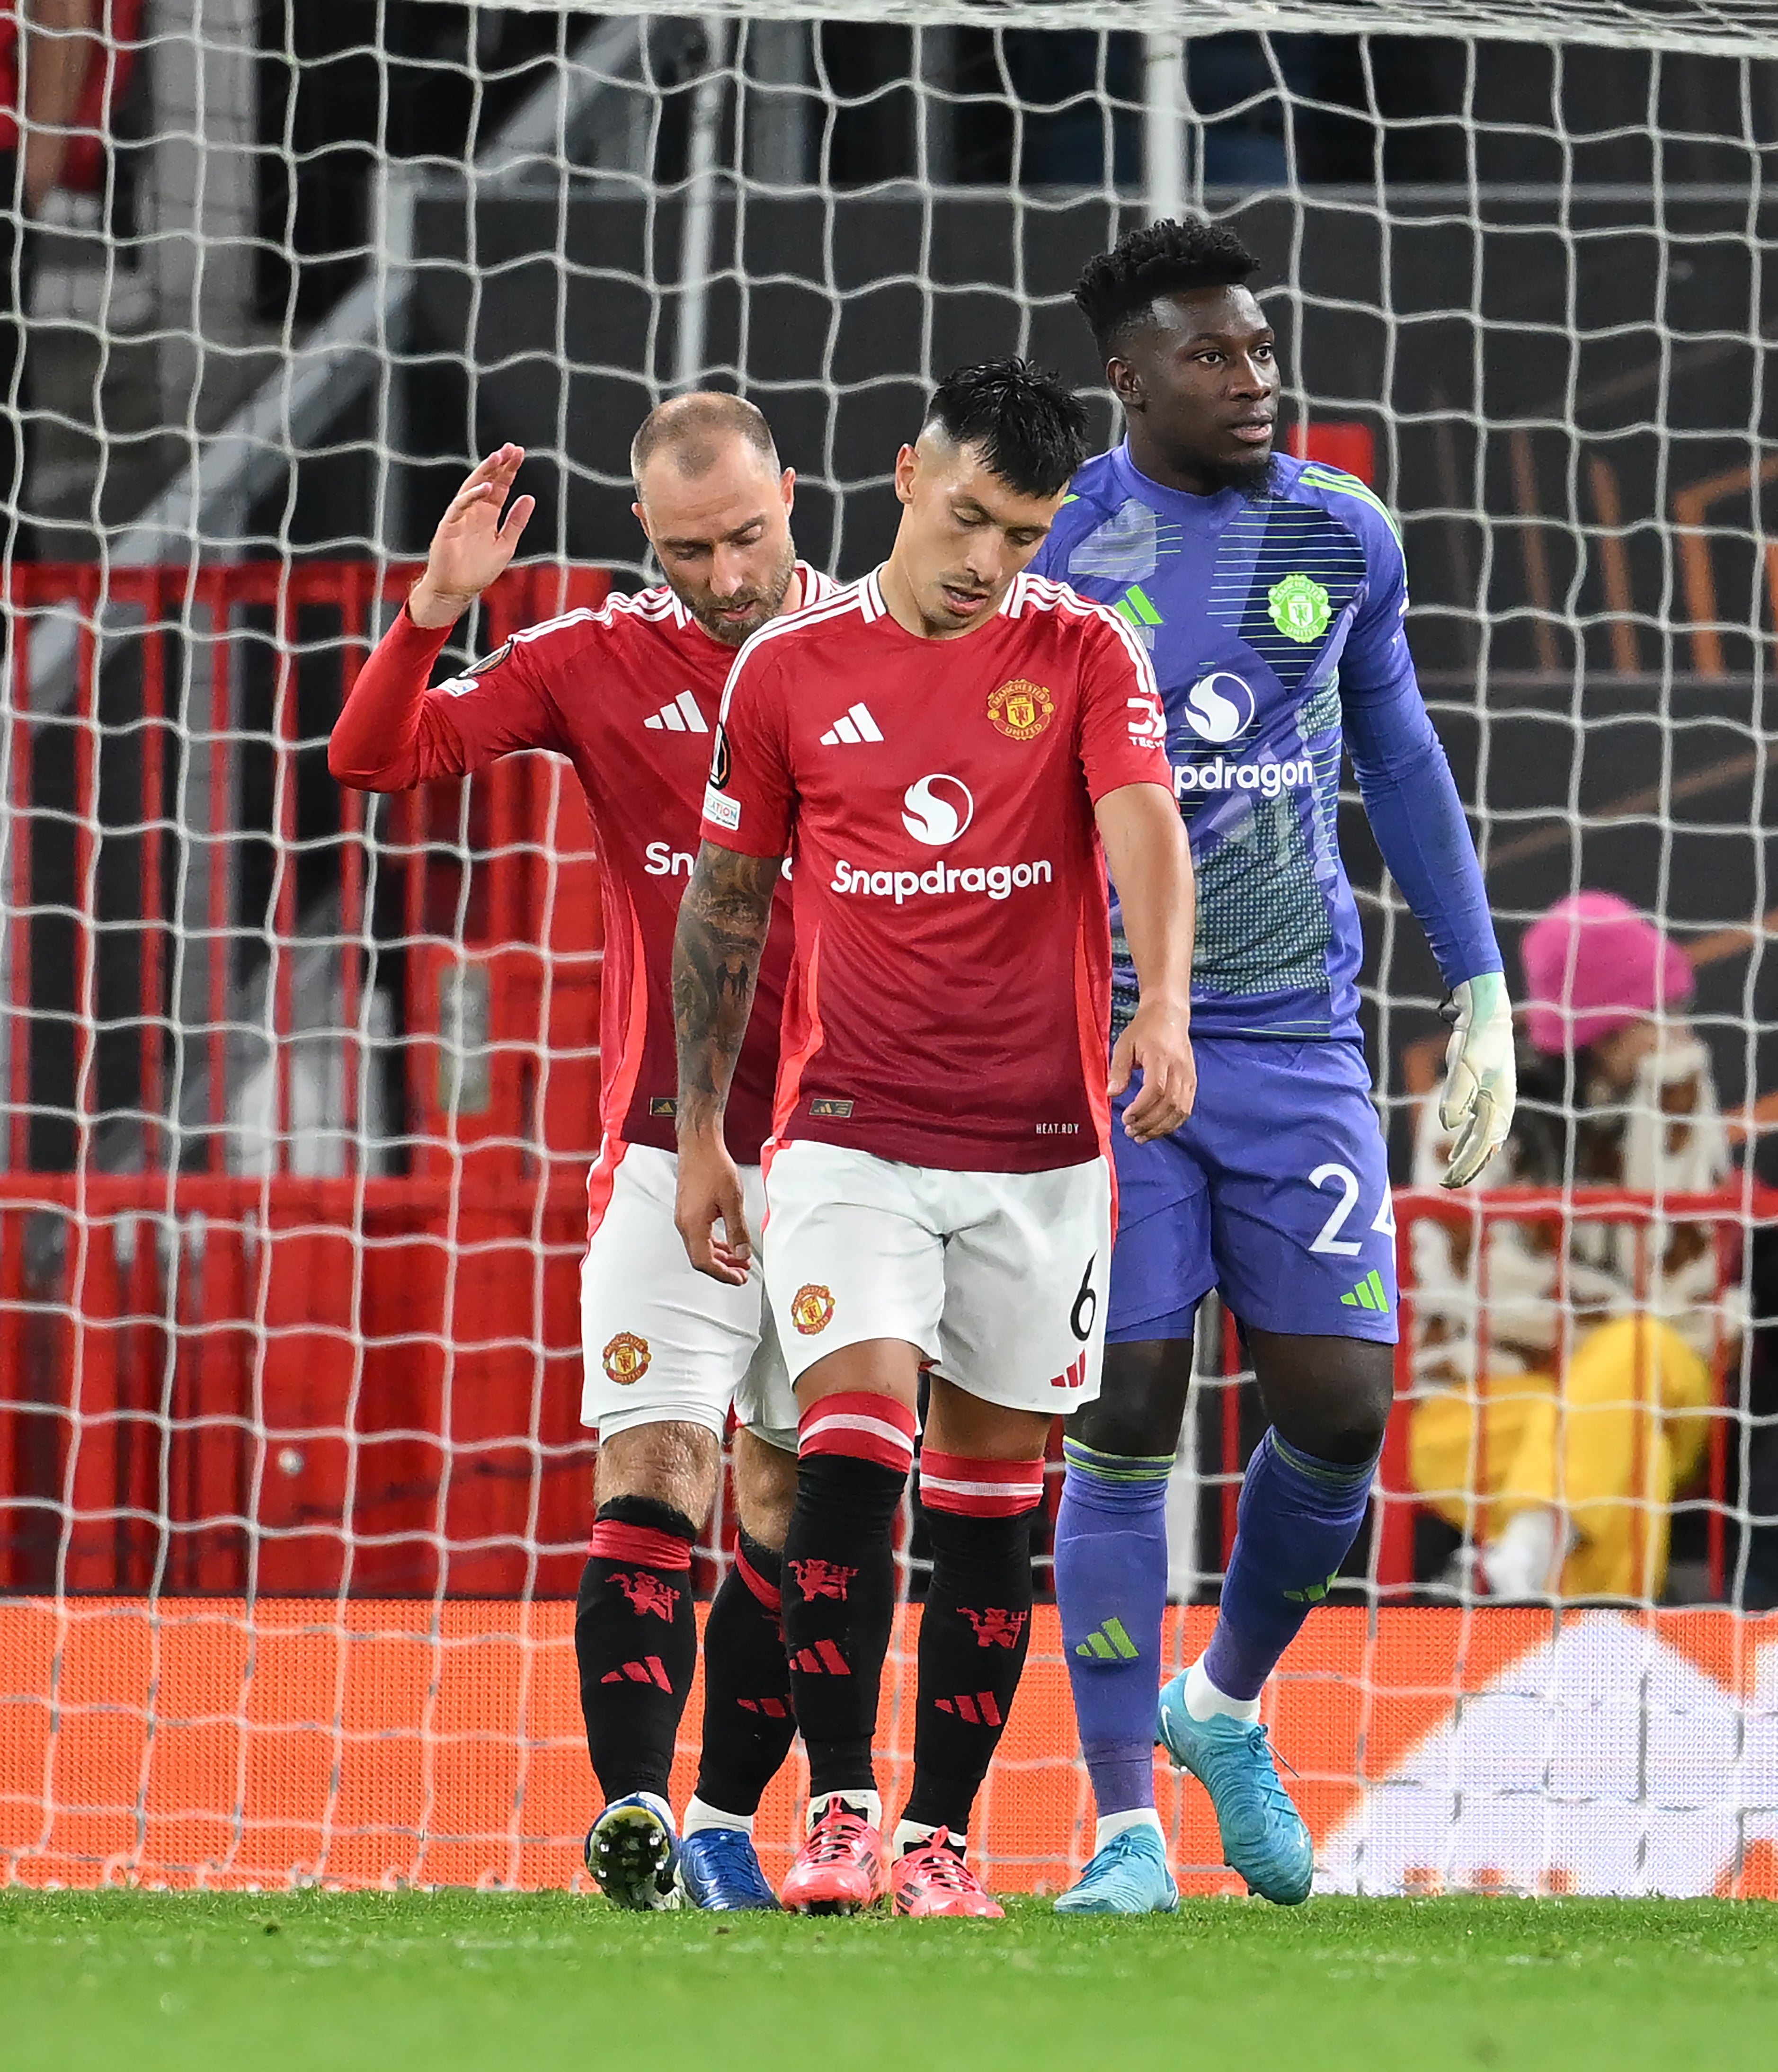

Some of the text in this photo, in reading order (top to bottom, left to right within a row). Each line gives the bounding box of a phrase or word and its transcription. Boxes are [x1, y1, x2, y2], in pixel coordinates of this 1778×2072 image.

[1286, 625, 1319, 636] UNITED
[993, 684, 1046, 706] MANCHESTER
[1005, 723, 1042, 736] UNITED
[1170, 757, 1313, 798] pdragon
[830, 860, 1051, 905] Snapdragon
[1308, 1163, 1396, 1270] 24
[1070, 1249, 1098, 1341] 6
